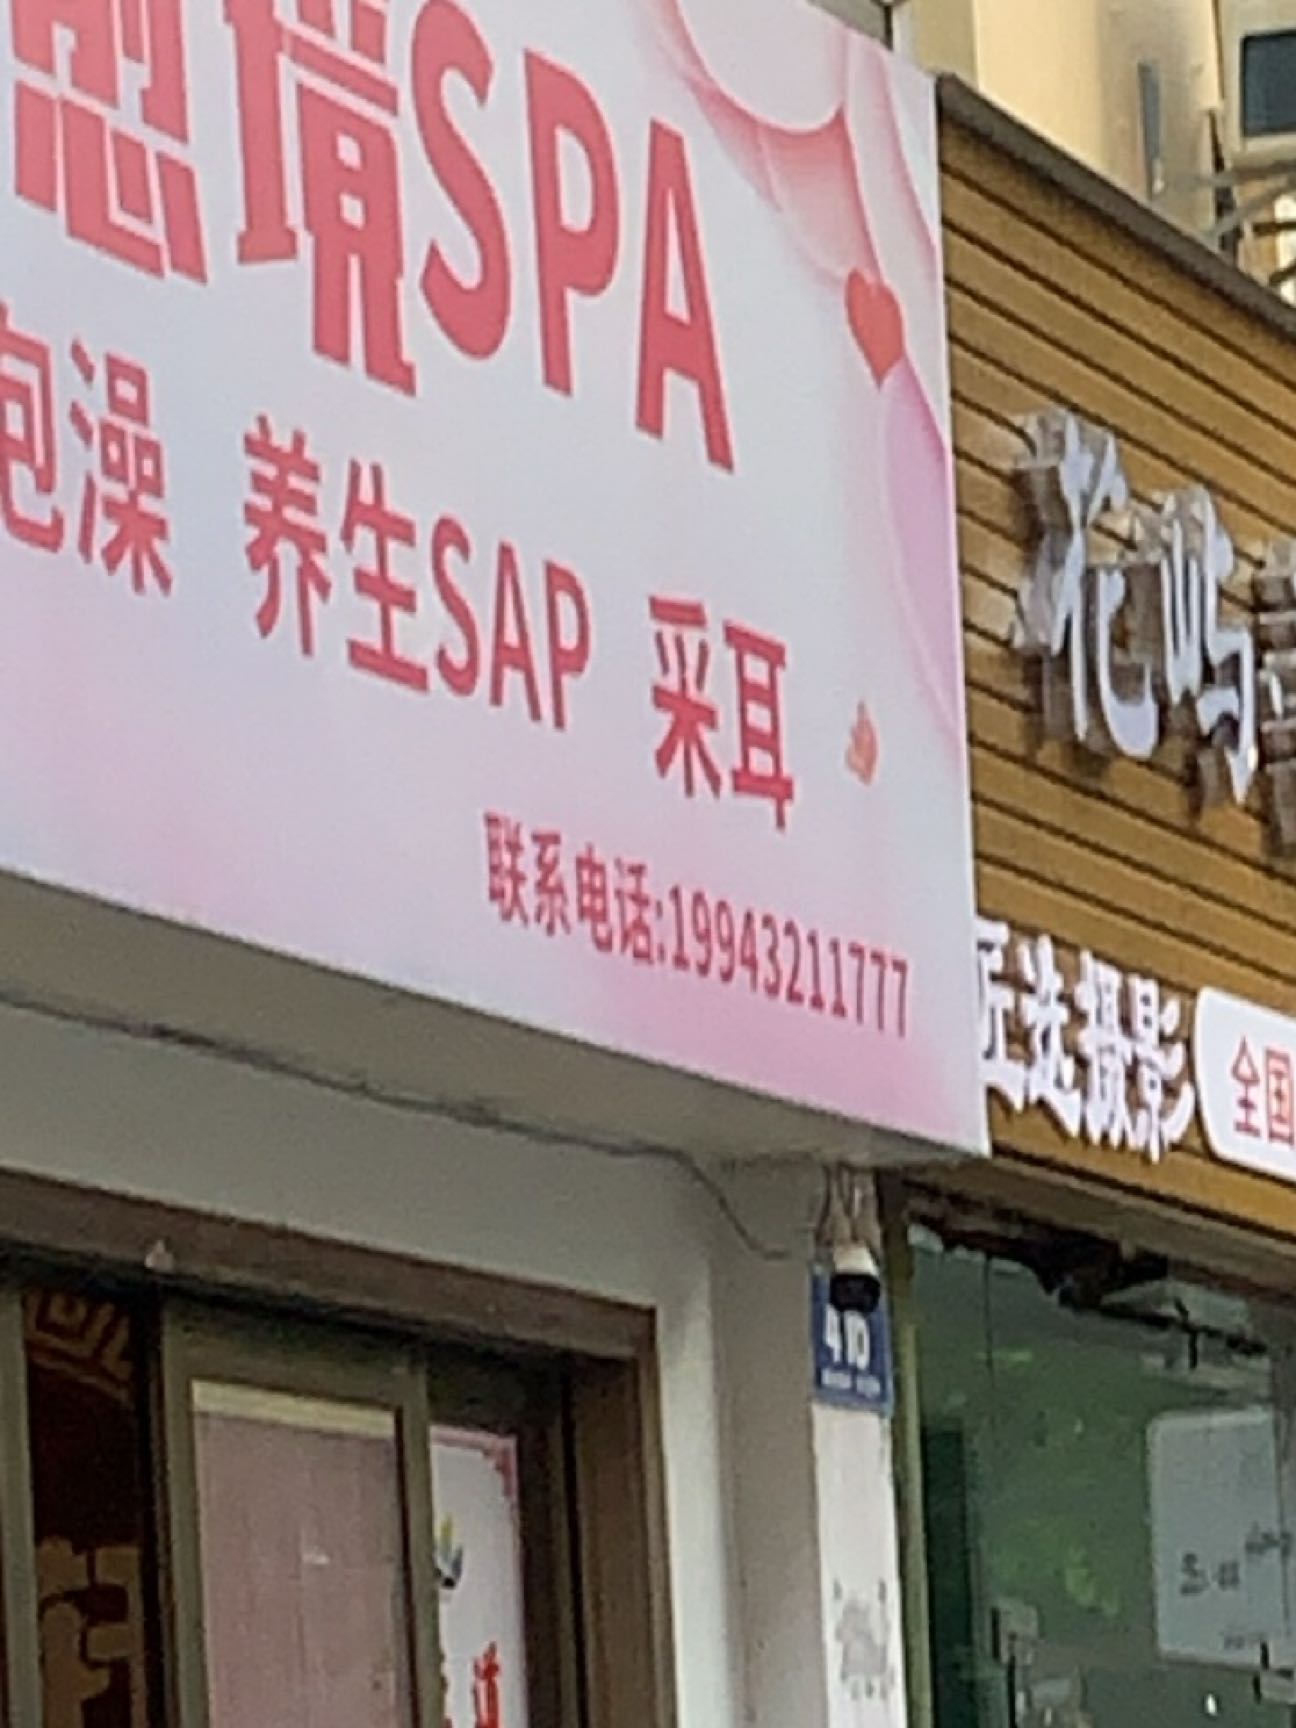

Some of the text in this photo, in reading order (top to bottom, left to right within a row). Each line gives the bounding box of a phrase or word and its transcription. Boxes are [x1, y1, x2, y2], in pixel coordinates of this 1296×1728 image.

[243, 414, 591, 731] 养生SAP
[648, 595, 795, 832] 采耳
[483, 810, 910, 1039] 联系电话:19943211777
